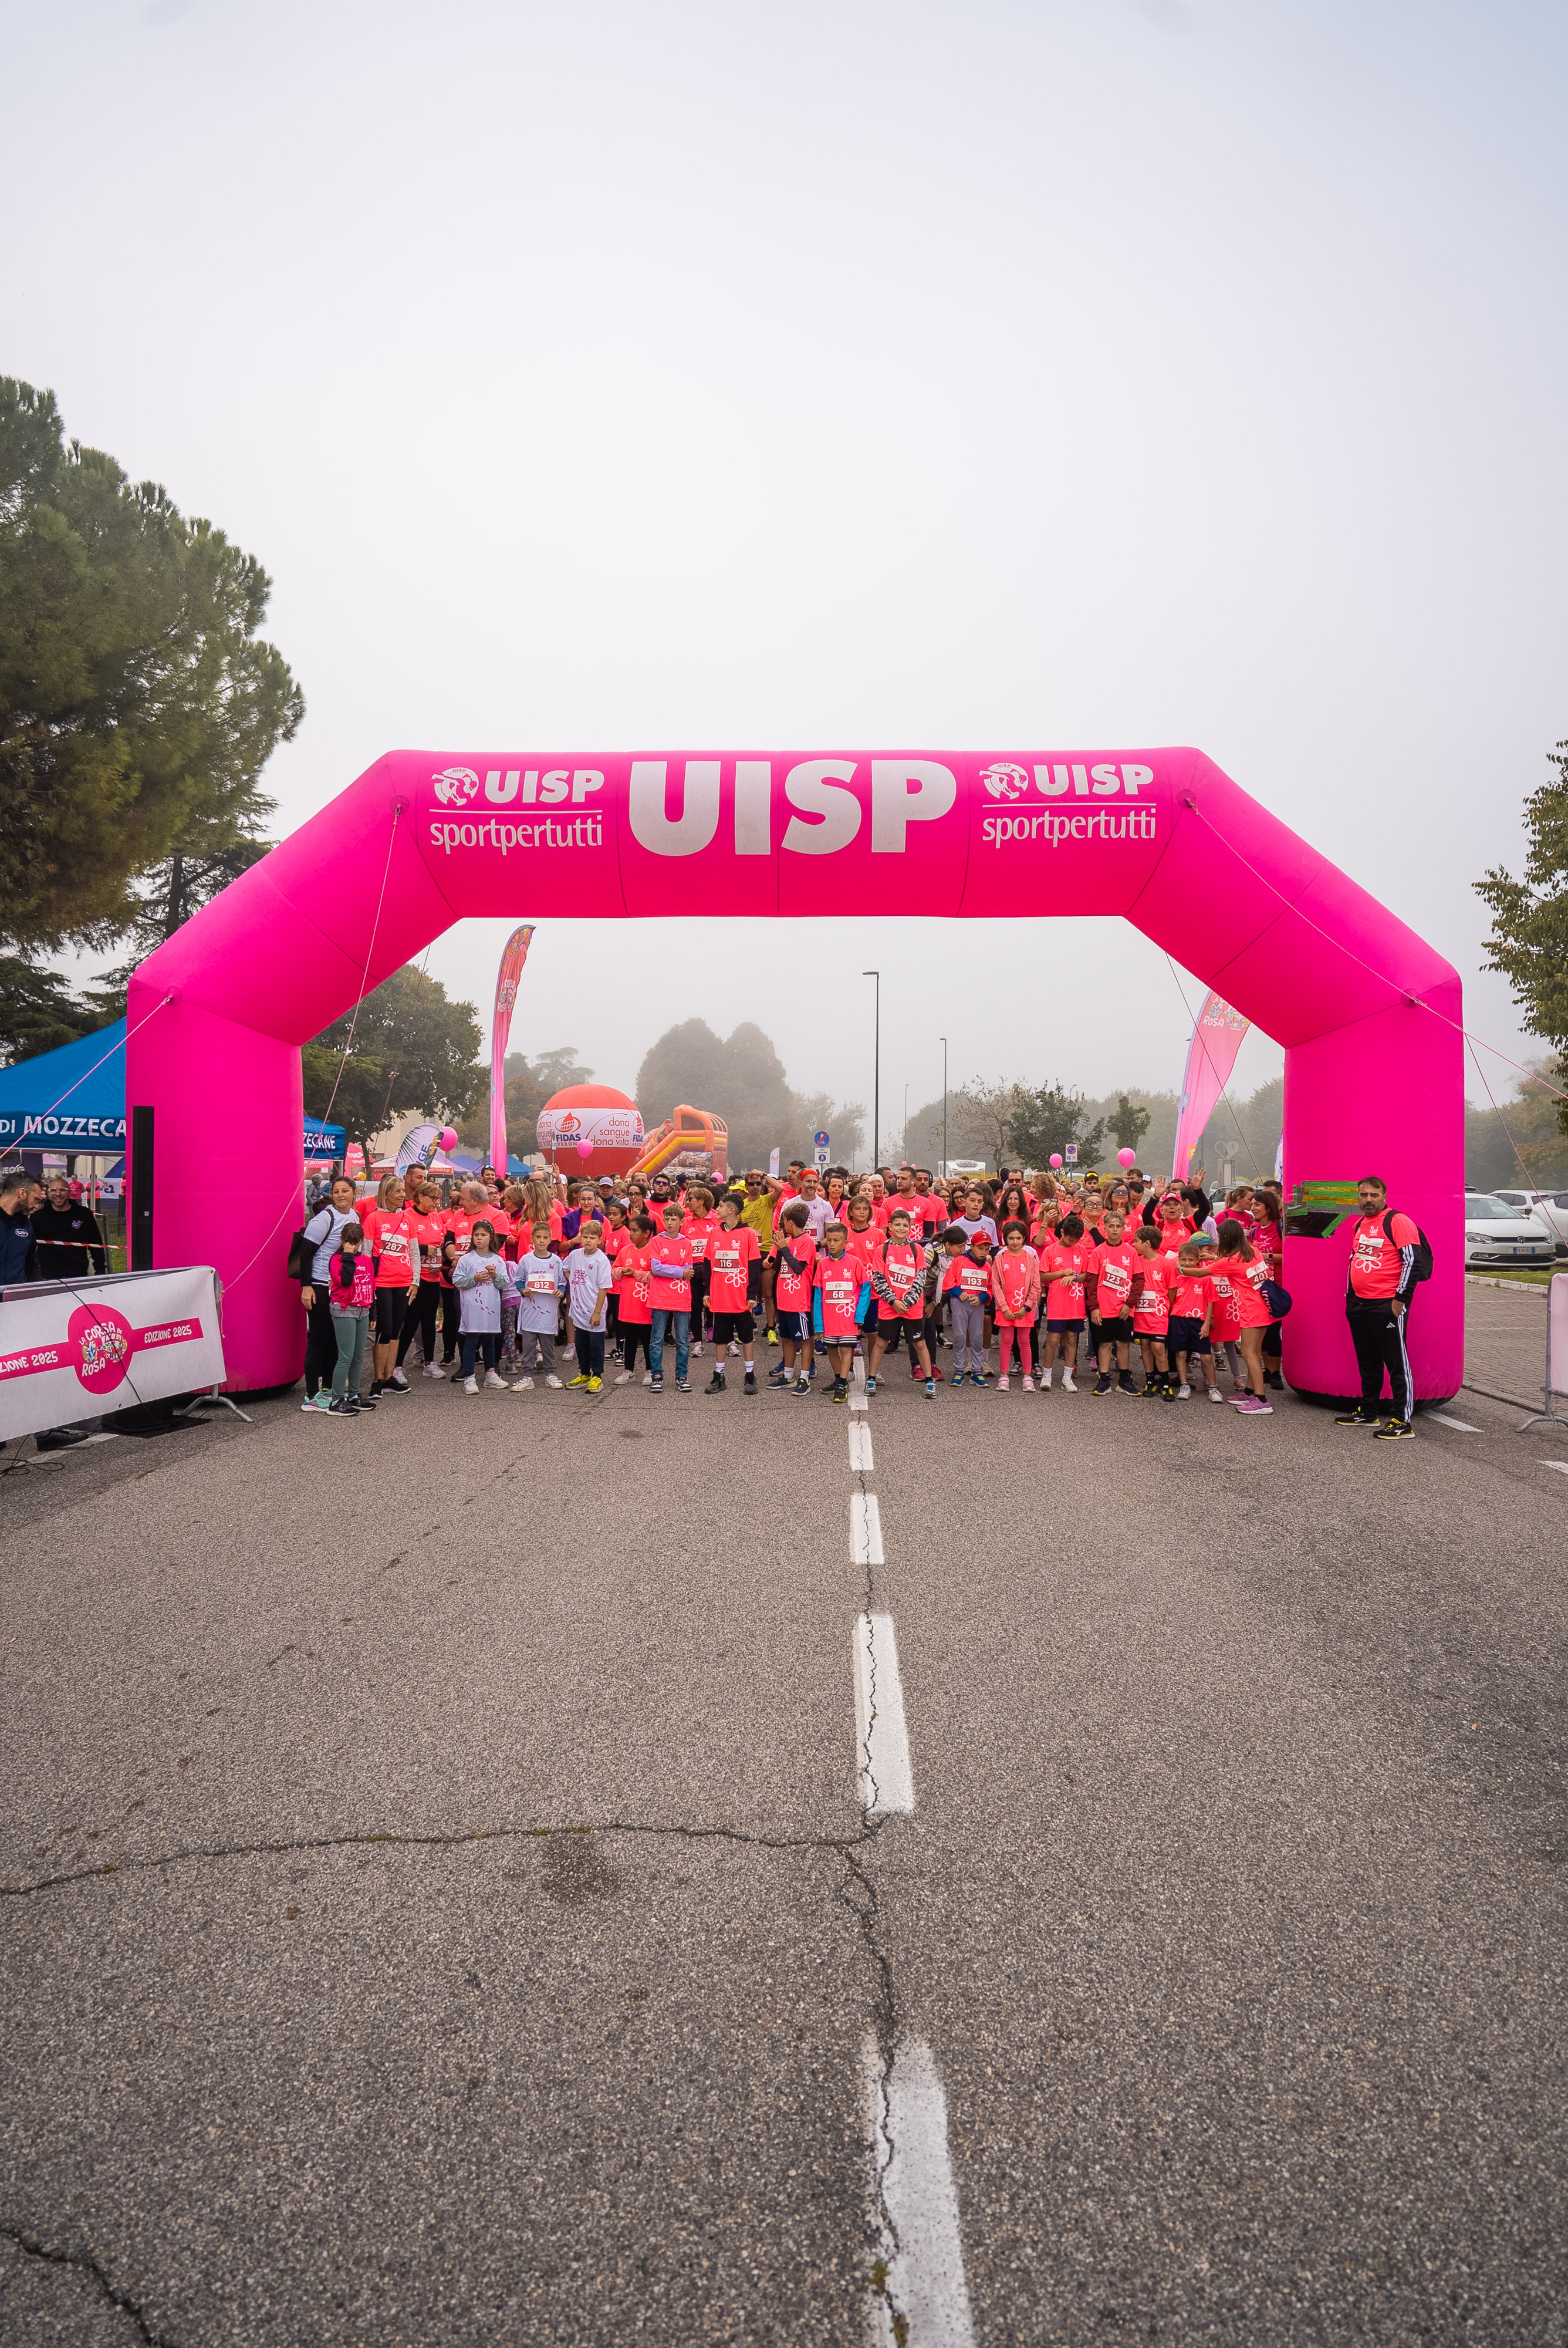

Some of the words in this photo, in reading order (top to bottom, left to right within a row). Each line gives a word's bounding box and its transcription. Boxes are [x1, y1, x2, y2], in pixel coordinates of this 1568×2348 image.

[1033, 764, 1154, 795] UISP
[484, 770, 605, 803] UISP
[628, 759, 957, 856] UISP
[982, 808, 1157, 849] sportpertutti
[430, 815, 603, 856] sportpertutti
[1202, 1015, 1225, 1028] ROSA
[0, 1119, 16, 1133] DI
[23, 1116, 127, 1137] MOZZECA
[609, 1116, 630, 1126] dona
[303, 1132, 336, 1149] ZECANE
[556, 1133, 581, 1142] FIDAS
[590, 1135, 613, 1146] dona
[616, 1136, 629, 1146] vita
[599, 1129, 630, 1139] sangue
[386, 1242, 403, 1251] 287
[1359, 1244, 1373, 1254] 24
[720, 1259, 732, 1267] 116
[894, 1273, 907, 1284] 115
[967, 1277, 982, 1286] 193
[1106, 1273, 1120, 1285] 123
[1253, 1270, 1269, 1283] 401
[832, 1290, 844, 1298] 68
[85, 1321, 116, 1341] CORSA
[144, 1328, 171, 1343] EDIZIONE
[173, 1325, 192, 1337] 2025
[0, 1357, 29, 1374] ZIONE
[31, 1351, 59, 1366] 2025
[82, 1357, 106, 1377] ROSA
